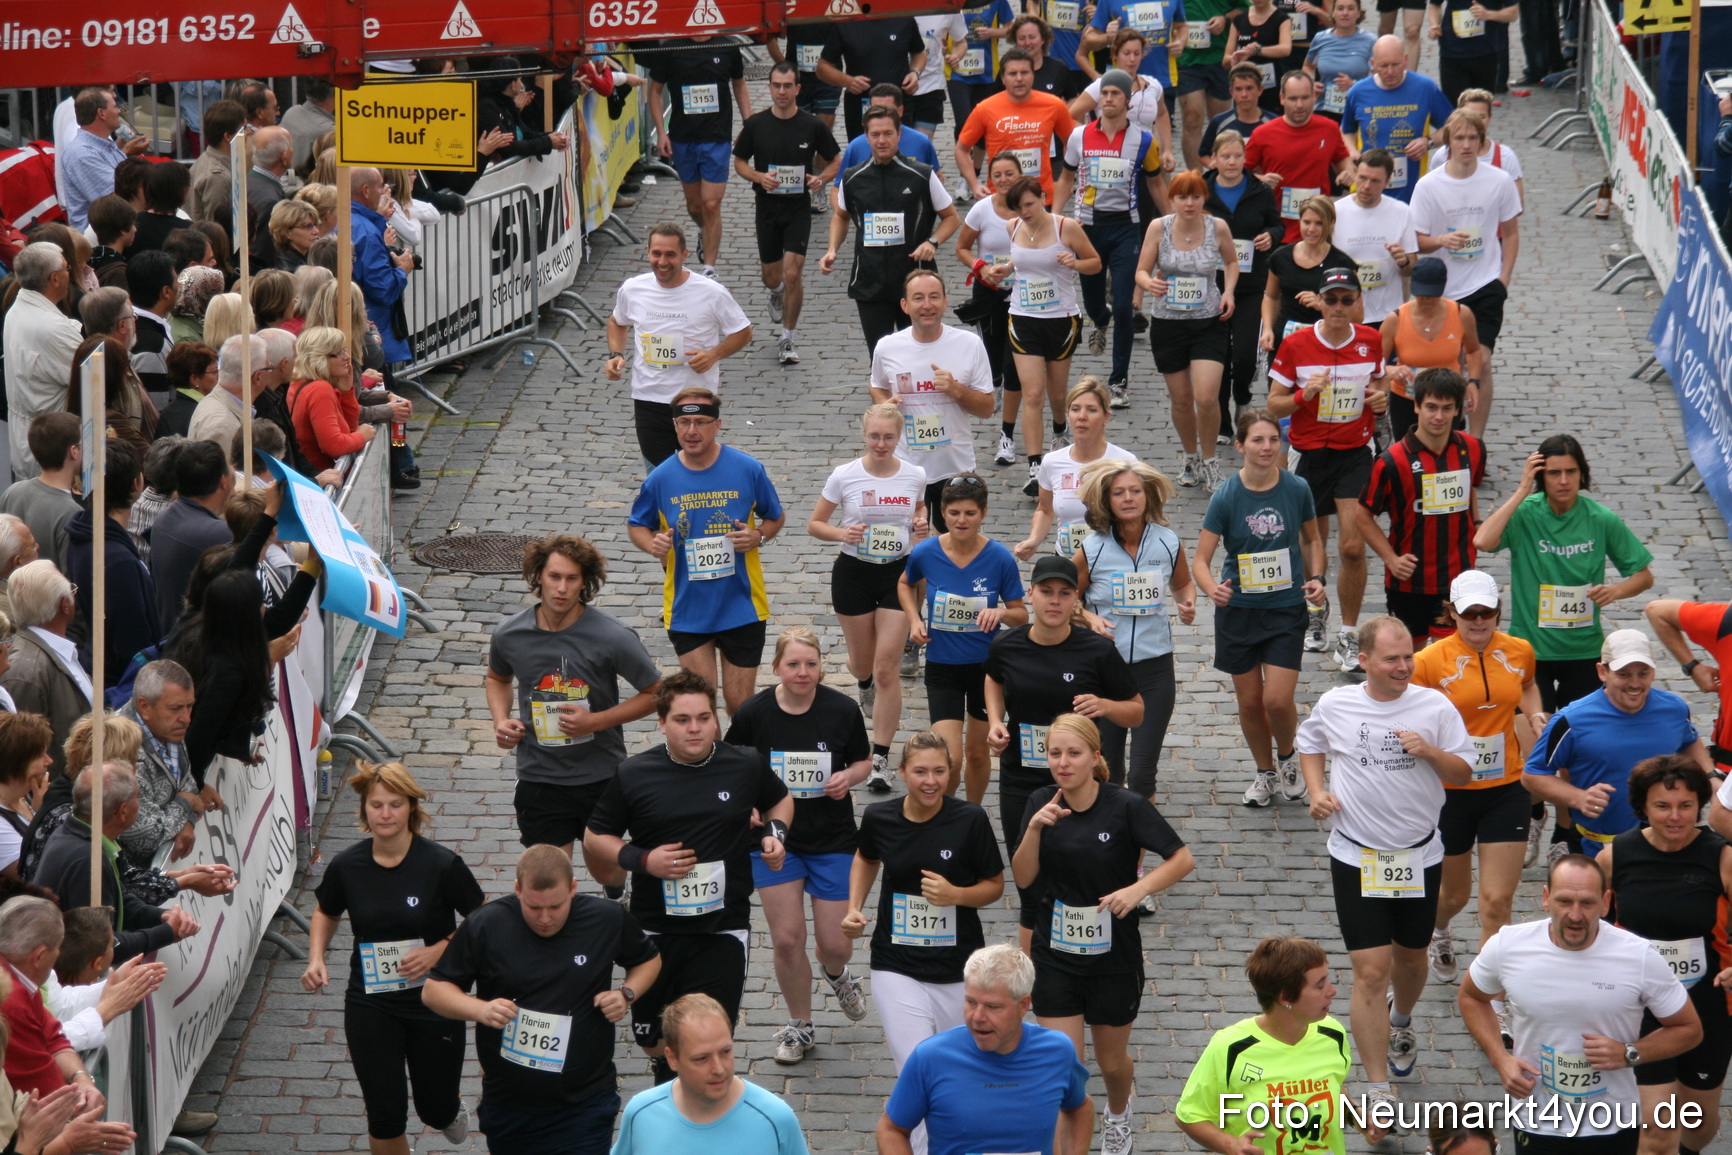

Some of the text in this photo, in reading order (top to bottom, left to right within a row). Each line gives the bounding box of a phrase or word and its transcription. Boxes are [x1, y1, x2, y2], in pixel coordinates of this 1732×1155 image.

[589, 0, 658, 28] 6352
[1138, 12, 1159, 21] 6004
[1464, 20, 1480, 29] 974
[0, 13, 255, 50] line: 09181 6352
[963, 59, 979, 67] 659
[693, 95, 715, 104] 3153
[346, 100, 466, 124] Schnupper-
[1004, 119, 1041, 131] Fischer
[388, 127, 426, 145] lauf
[1022, 160, 1038, 169] 594
[779, 176, 801, 184] 3152
[1101, 169, 1124, 179] 3784
[875, 225, 900, 235] 3695
[1362, 272, 1382, 281] 728
[1030, 289, 1055, 301] 3078
[1177, 290, 1202, 299] 3079
[655, 348, 677, 359] 705
[1336, 398, 1358, 409] 177
[917, 426, 946, 439] 2461
[670, 490, 739, 505] 10. NEUMARKTER
[1441, 486, 1464, 500] 190
[680, 500, 728, 511] STADTLAUF
[878, 496, 911, 505] HAARE
[872, 528, 895, 538] Sandra
[695, 540, 723, 551] Gerhard
[872, 540, 903, 552] 2459
[698, 552, 731, 567] 2022
[1252, 556, 1277, 566] Bettina
[1259, 566, 1282, 580] 191
[1127, 576, 1147, 585] Ulrike
[1128, 587, 1159, 600] 3136
[948, 597, 965, 607] Erika
[1560, 602, 1586, 614] 443
[948, 609, 980, 621] 2898
[1035, 729, 1046, 737] Tin
[787, 756, 818, 767] Johanna
[1373, 756, 1416, 767] Neumarkter
[1475, 751, 1499, 767] 767
[1384, 762, 1416, 773] Stadtlauf
[788, 770, 824, 784] 3170
[1378, 852, 1395, 864] Ingo
[1384, 867, 1413, 881] 923
[681, 881, 719, 899] 3173
[909, 900, 929, 913] Lissy
[1065, 910, 1084, 921] Kathi
[910, 915, 947, 930] 3171
[1066, 924, 1103, 938] 3161
[376, 946, 400, 958] Steffi
[520, 1013, 551, 1030] Florian
[634, 1022, 650, 1035] 27
[519, 1030, 561, 1052] 3162
[1557, 1056, 1591, 1070] Bernha
[1558, 1071, 1602, 1088] 2725
[1266, 1078, 1329, 1099] Müller
